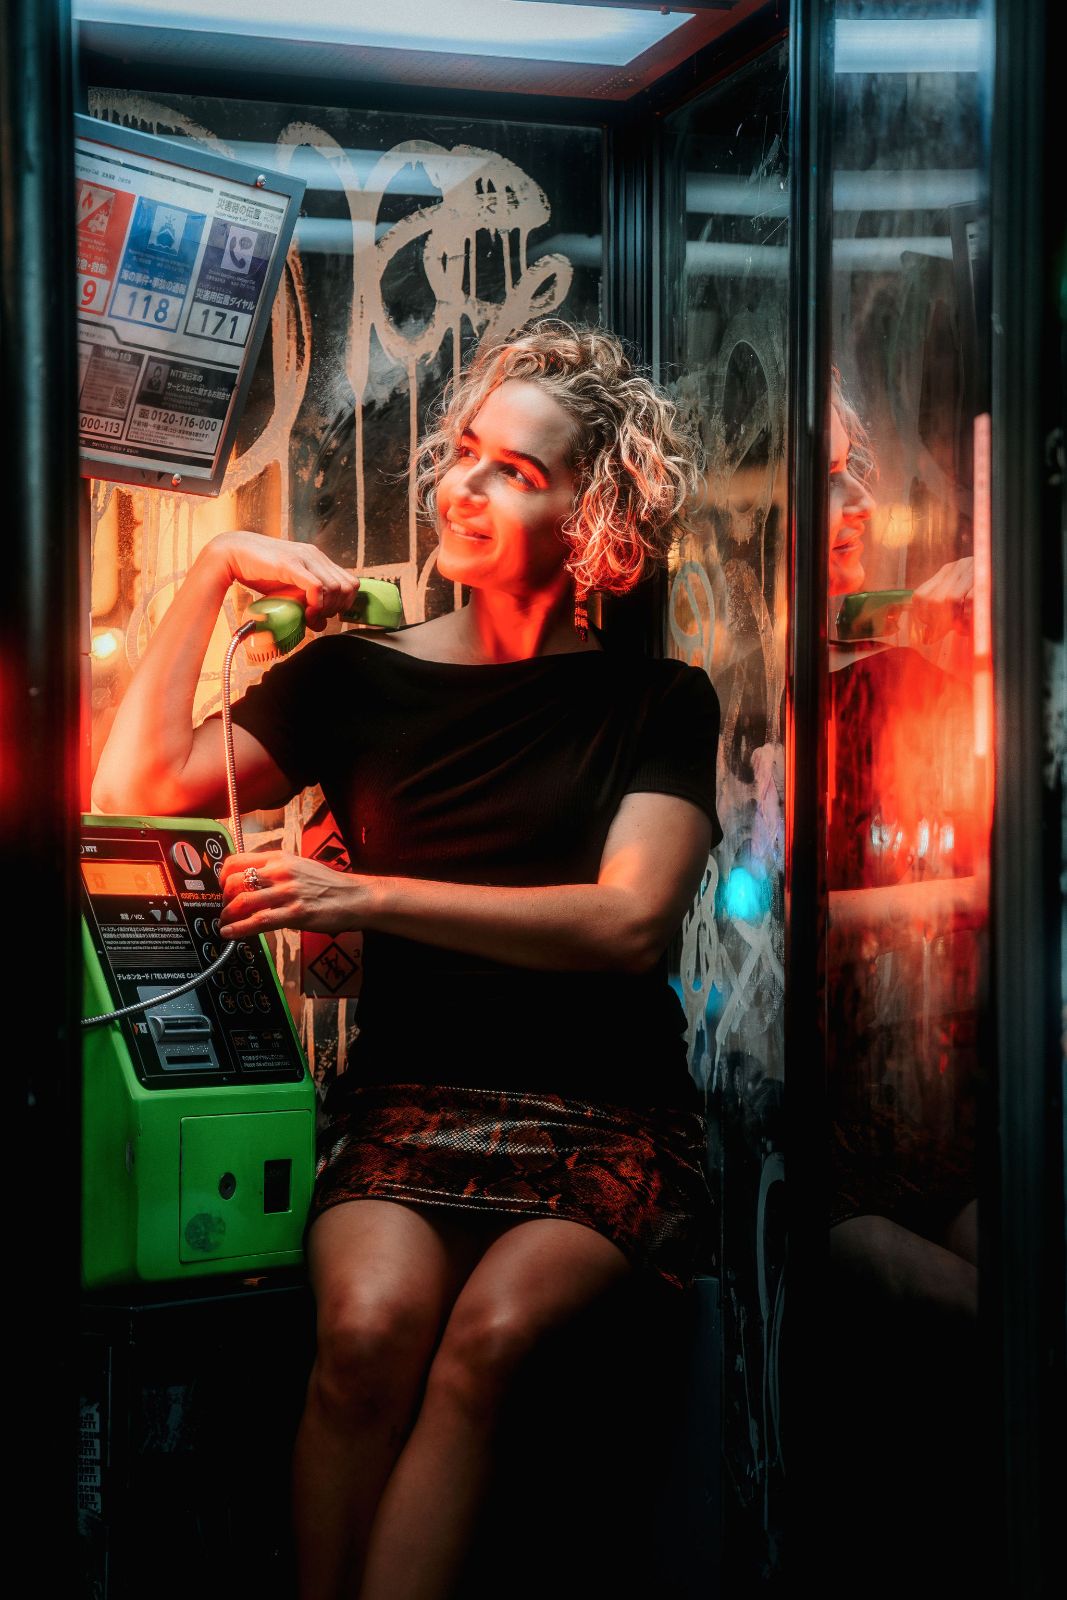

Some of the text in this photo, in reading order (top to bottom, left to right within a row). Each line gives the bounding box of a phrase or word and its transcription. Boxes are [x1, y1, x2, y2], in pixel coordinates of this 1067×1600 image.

[127, 291, 170, 324] 118
[201, 309, 238, 340] 171
[80, 416, 120, 434] 000-113
[150, 410, 217, 432] 0120-116-000
